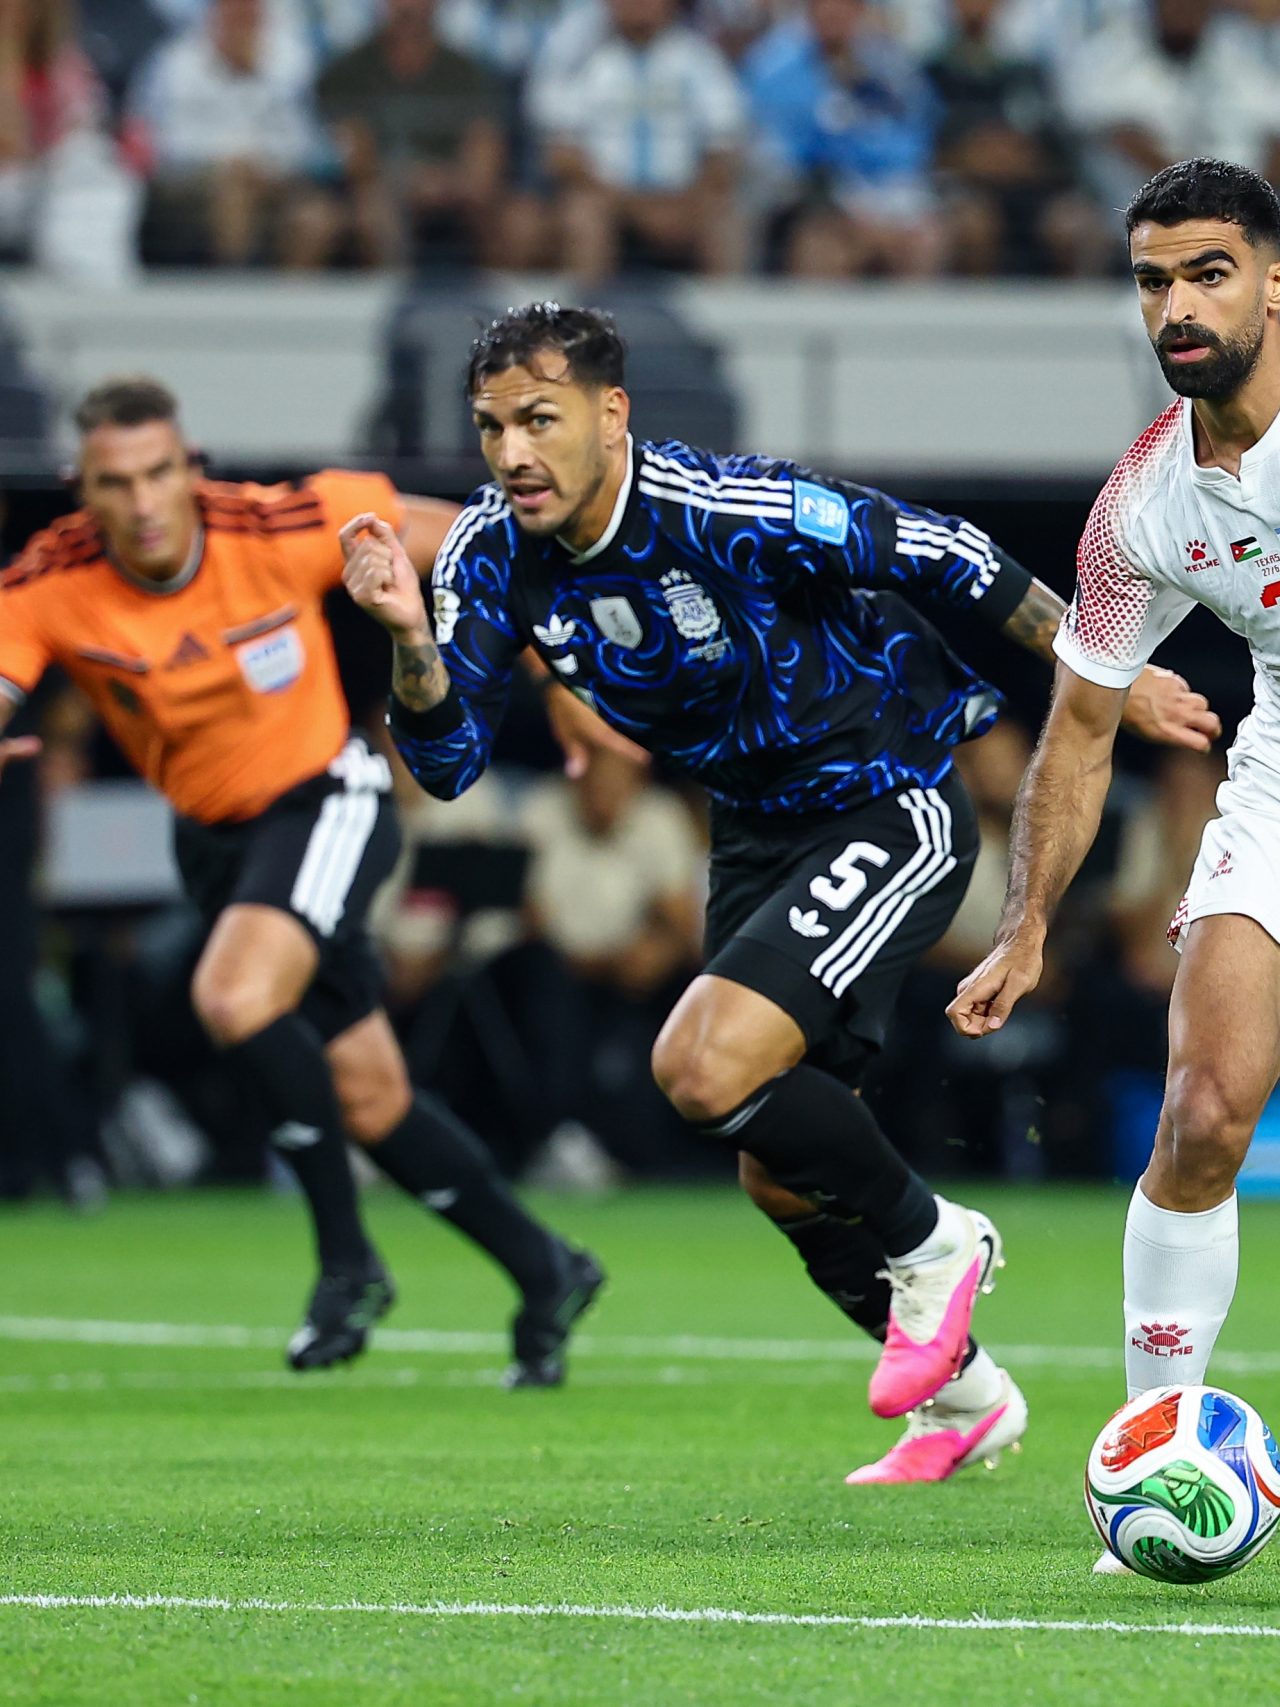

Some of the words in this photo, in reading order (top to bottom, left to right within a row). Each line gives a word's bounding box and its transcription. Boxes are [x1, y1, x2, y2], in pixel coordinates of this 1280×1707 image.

[1184, 558, 1220, 574] KELME
[809, 841, 891, 911] 5
[1131, 1337, 1194, 1357] KELME
